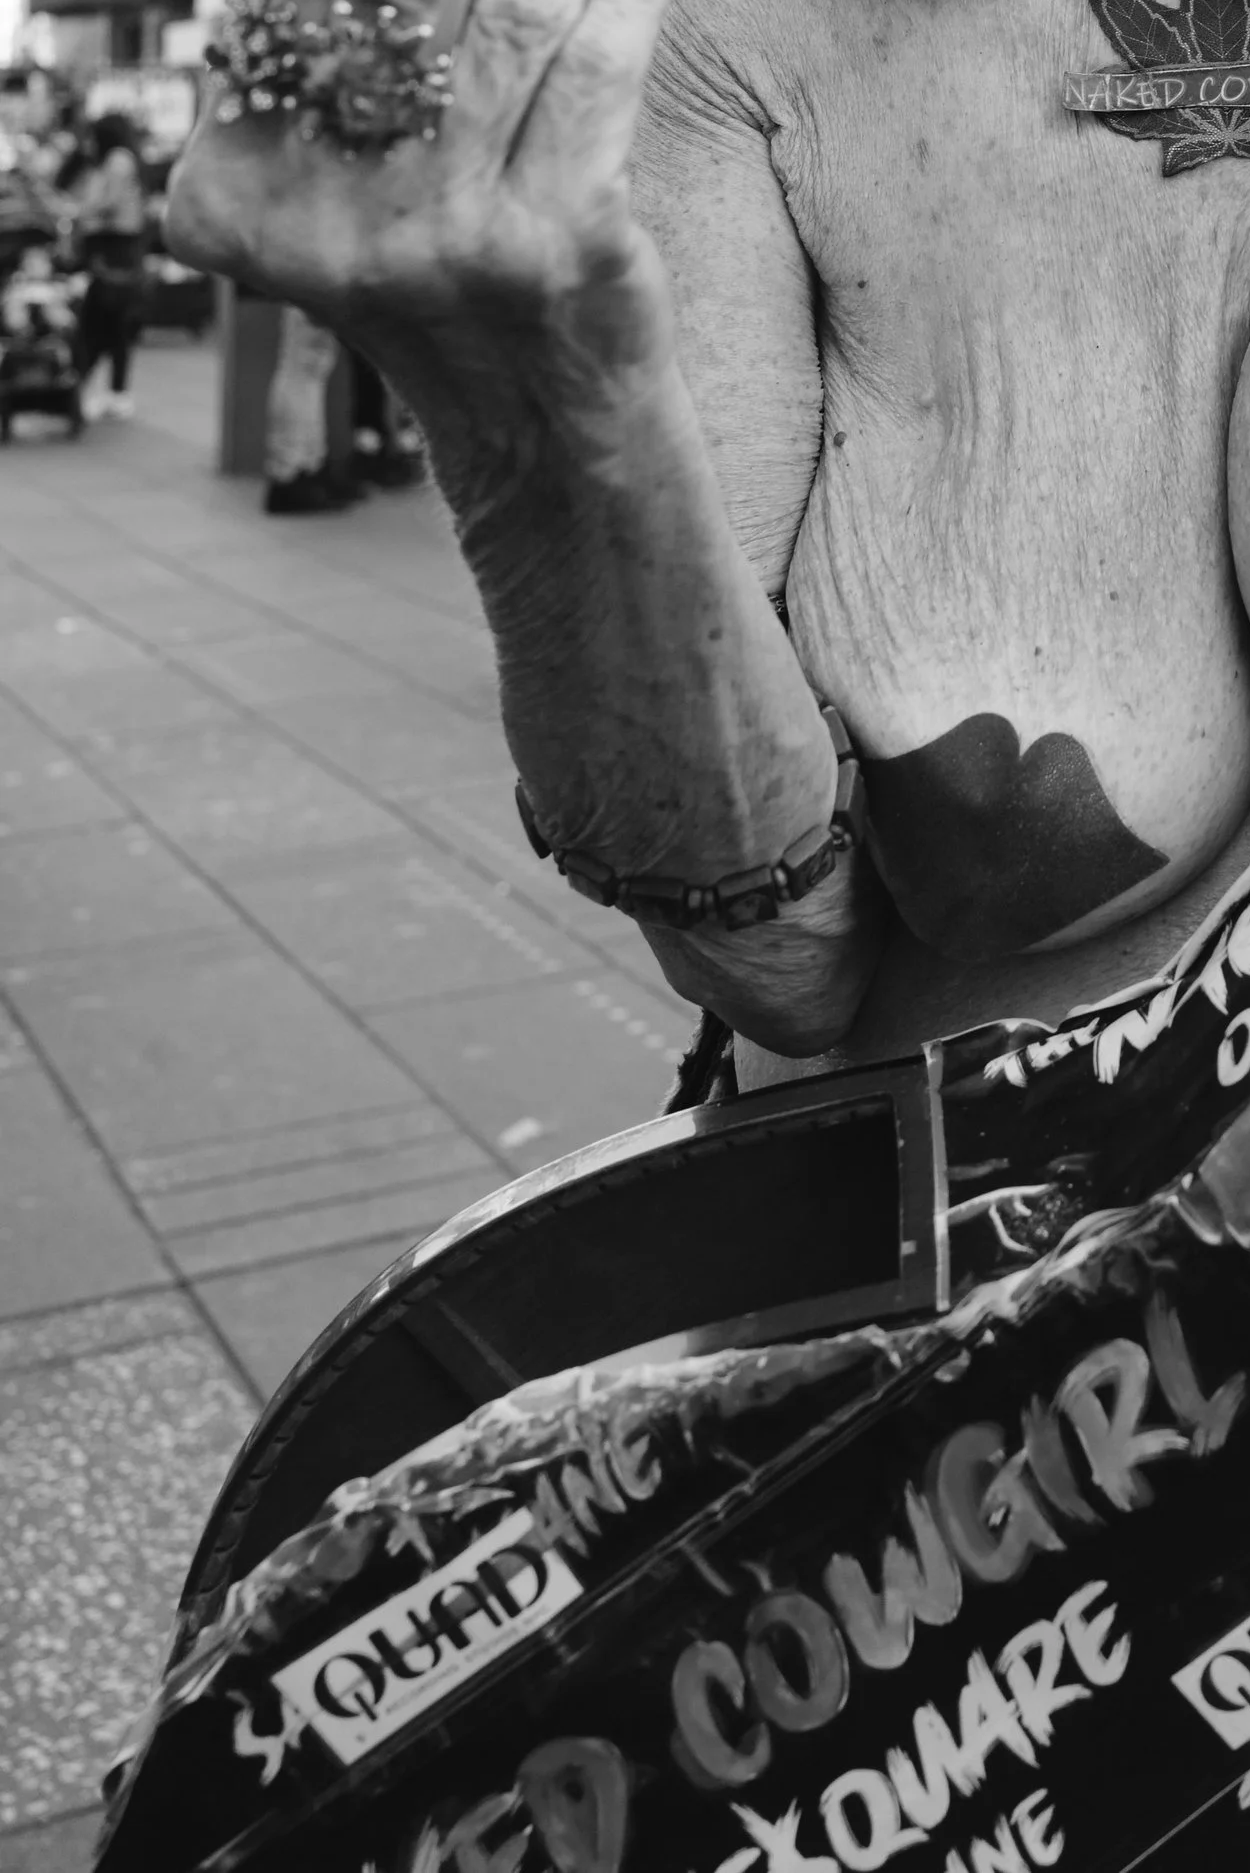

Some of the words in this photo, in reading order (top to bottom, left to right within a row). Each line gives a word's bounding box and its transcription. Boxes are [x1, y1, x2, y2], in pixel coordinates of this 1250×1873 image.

[1065, 76, 1187, 110] NAKED
[671, 1286, 1247, 1790] COWGIRL
[313, 1543, 550, 1723] QUAD
